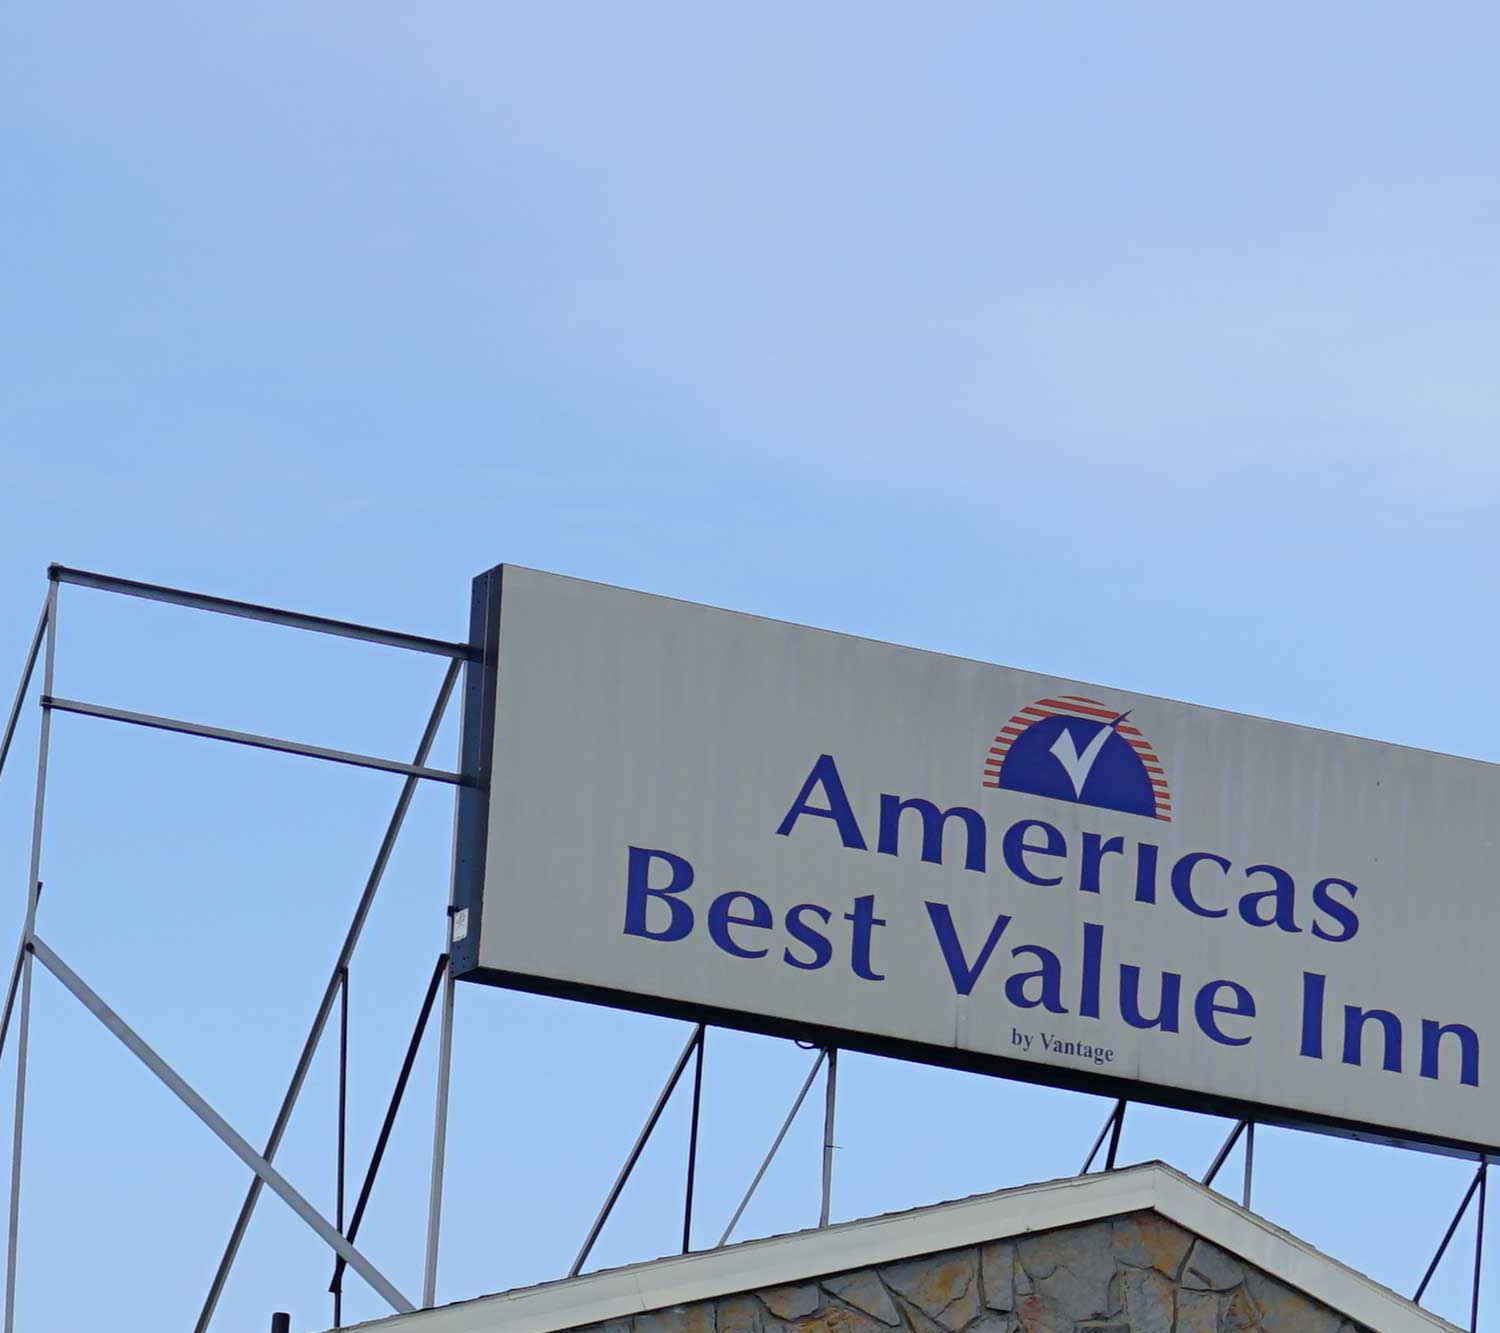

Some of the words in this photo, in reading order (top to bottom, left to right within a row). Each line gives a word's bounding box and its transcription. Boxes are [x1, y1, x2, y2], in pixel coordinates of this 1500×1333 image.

[776, 755, 1360, 943] Americas
[623, 846, 887, 982] Best
[924, 900, 1257, 1047] Value
[1300, 971, 1480, 1088] Inn
[1010, 1027, 1034, 1052] by
[1040, 1032, 1114, 1065] Vantage
